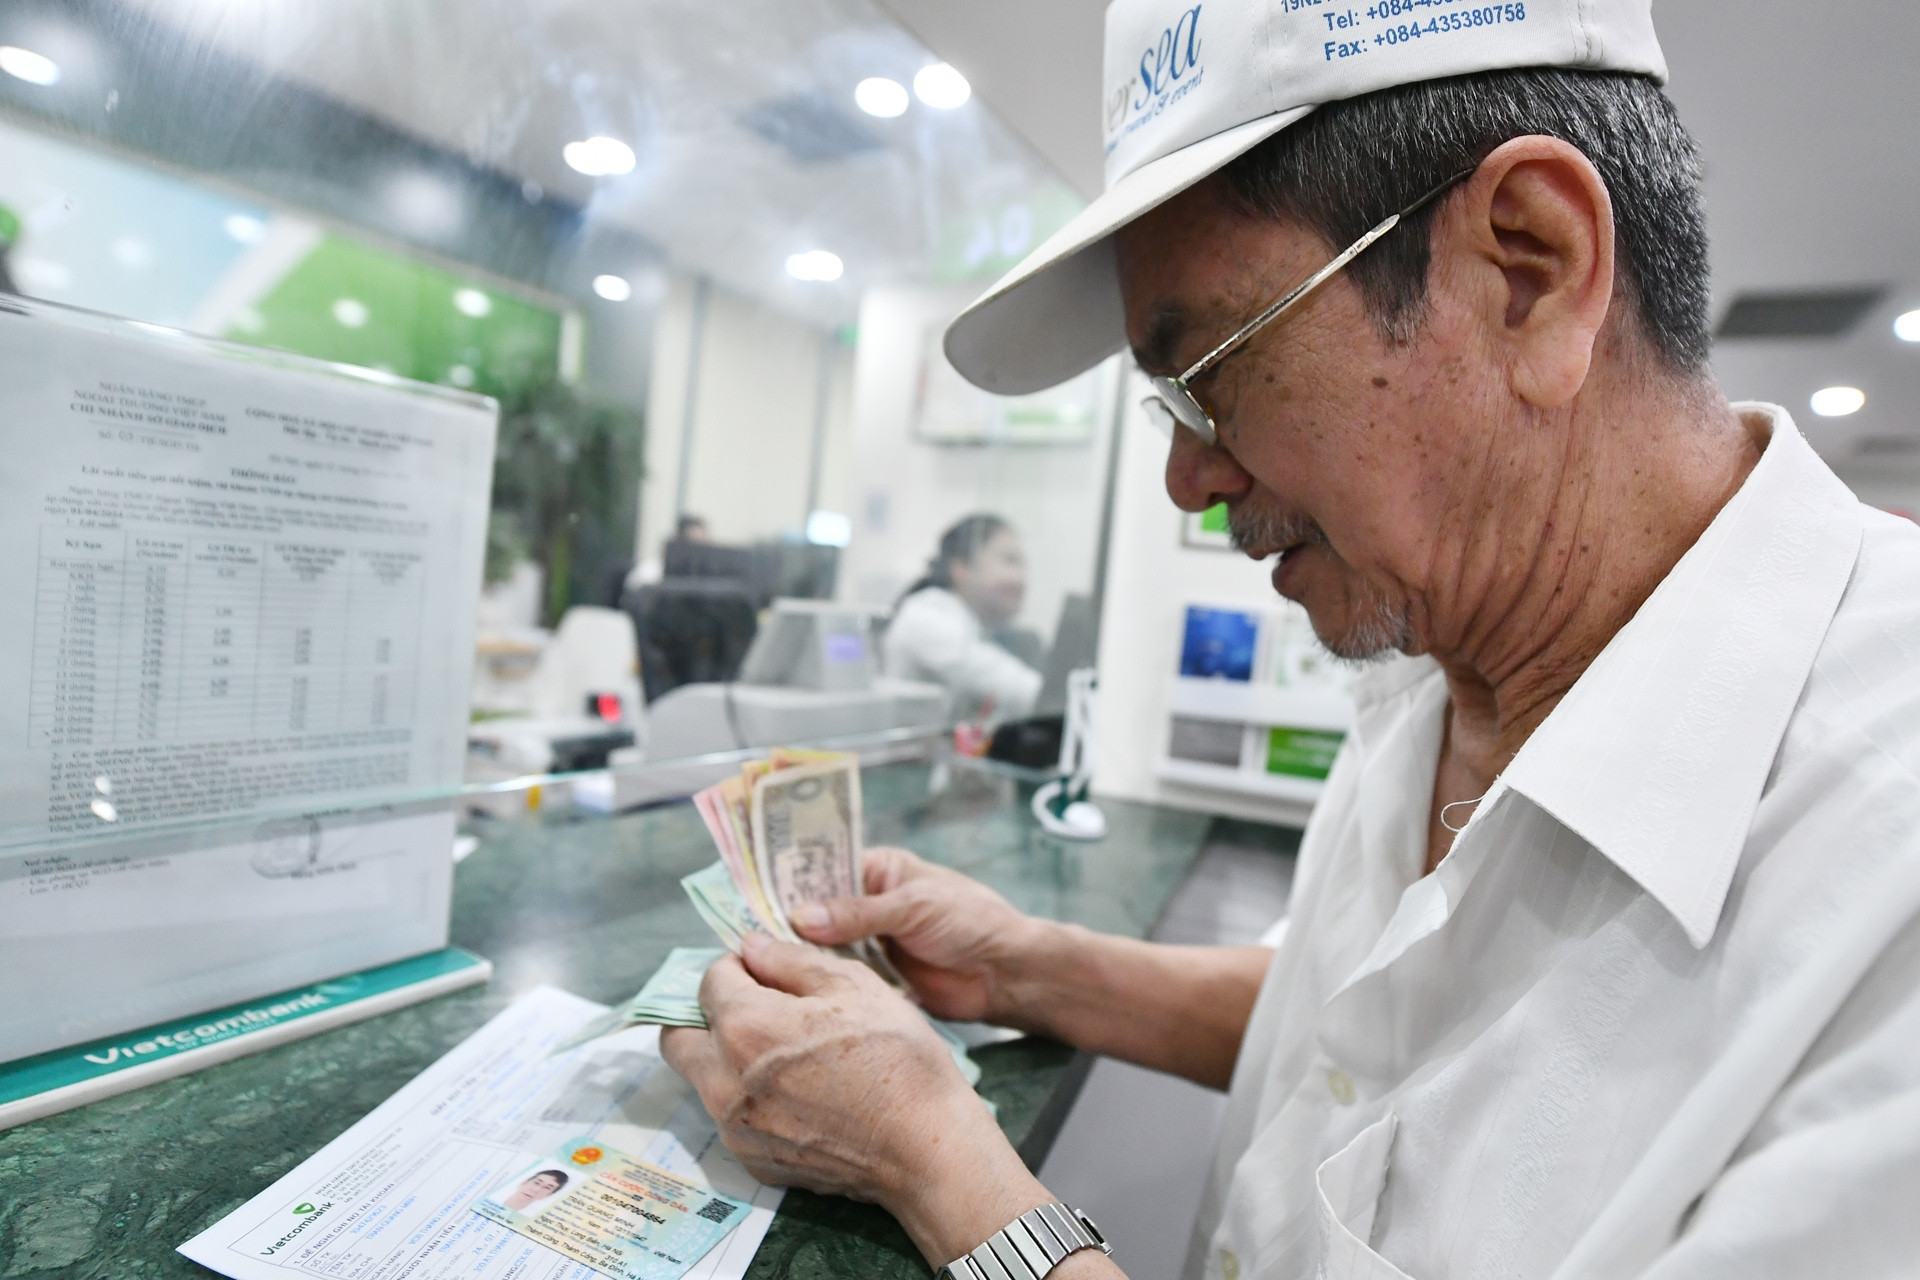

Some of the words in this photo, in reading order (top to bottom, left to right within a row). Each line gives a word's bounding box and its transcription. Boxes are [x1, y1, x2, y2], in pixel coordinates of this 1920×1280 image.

[1323, 10, 1360, 31] Tel:
[1324, 38, 1368, 60] Fax:
[1373, 2, 1526, 46] +084-435380758
[84, 992, 330, 1065] Vietcombank
[260, 1201, 335, 1257] Vietcombank
